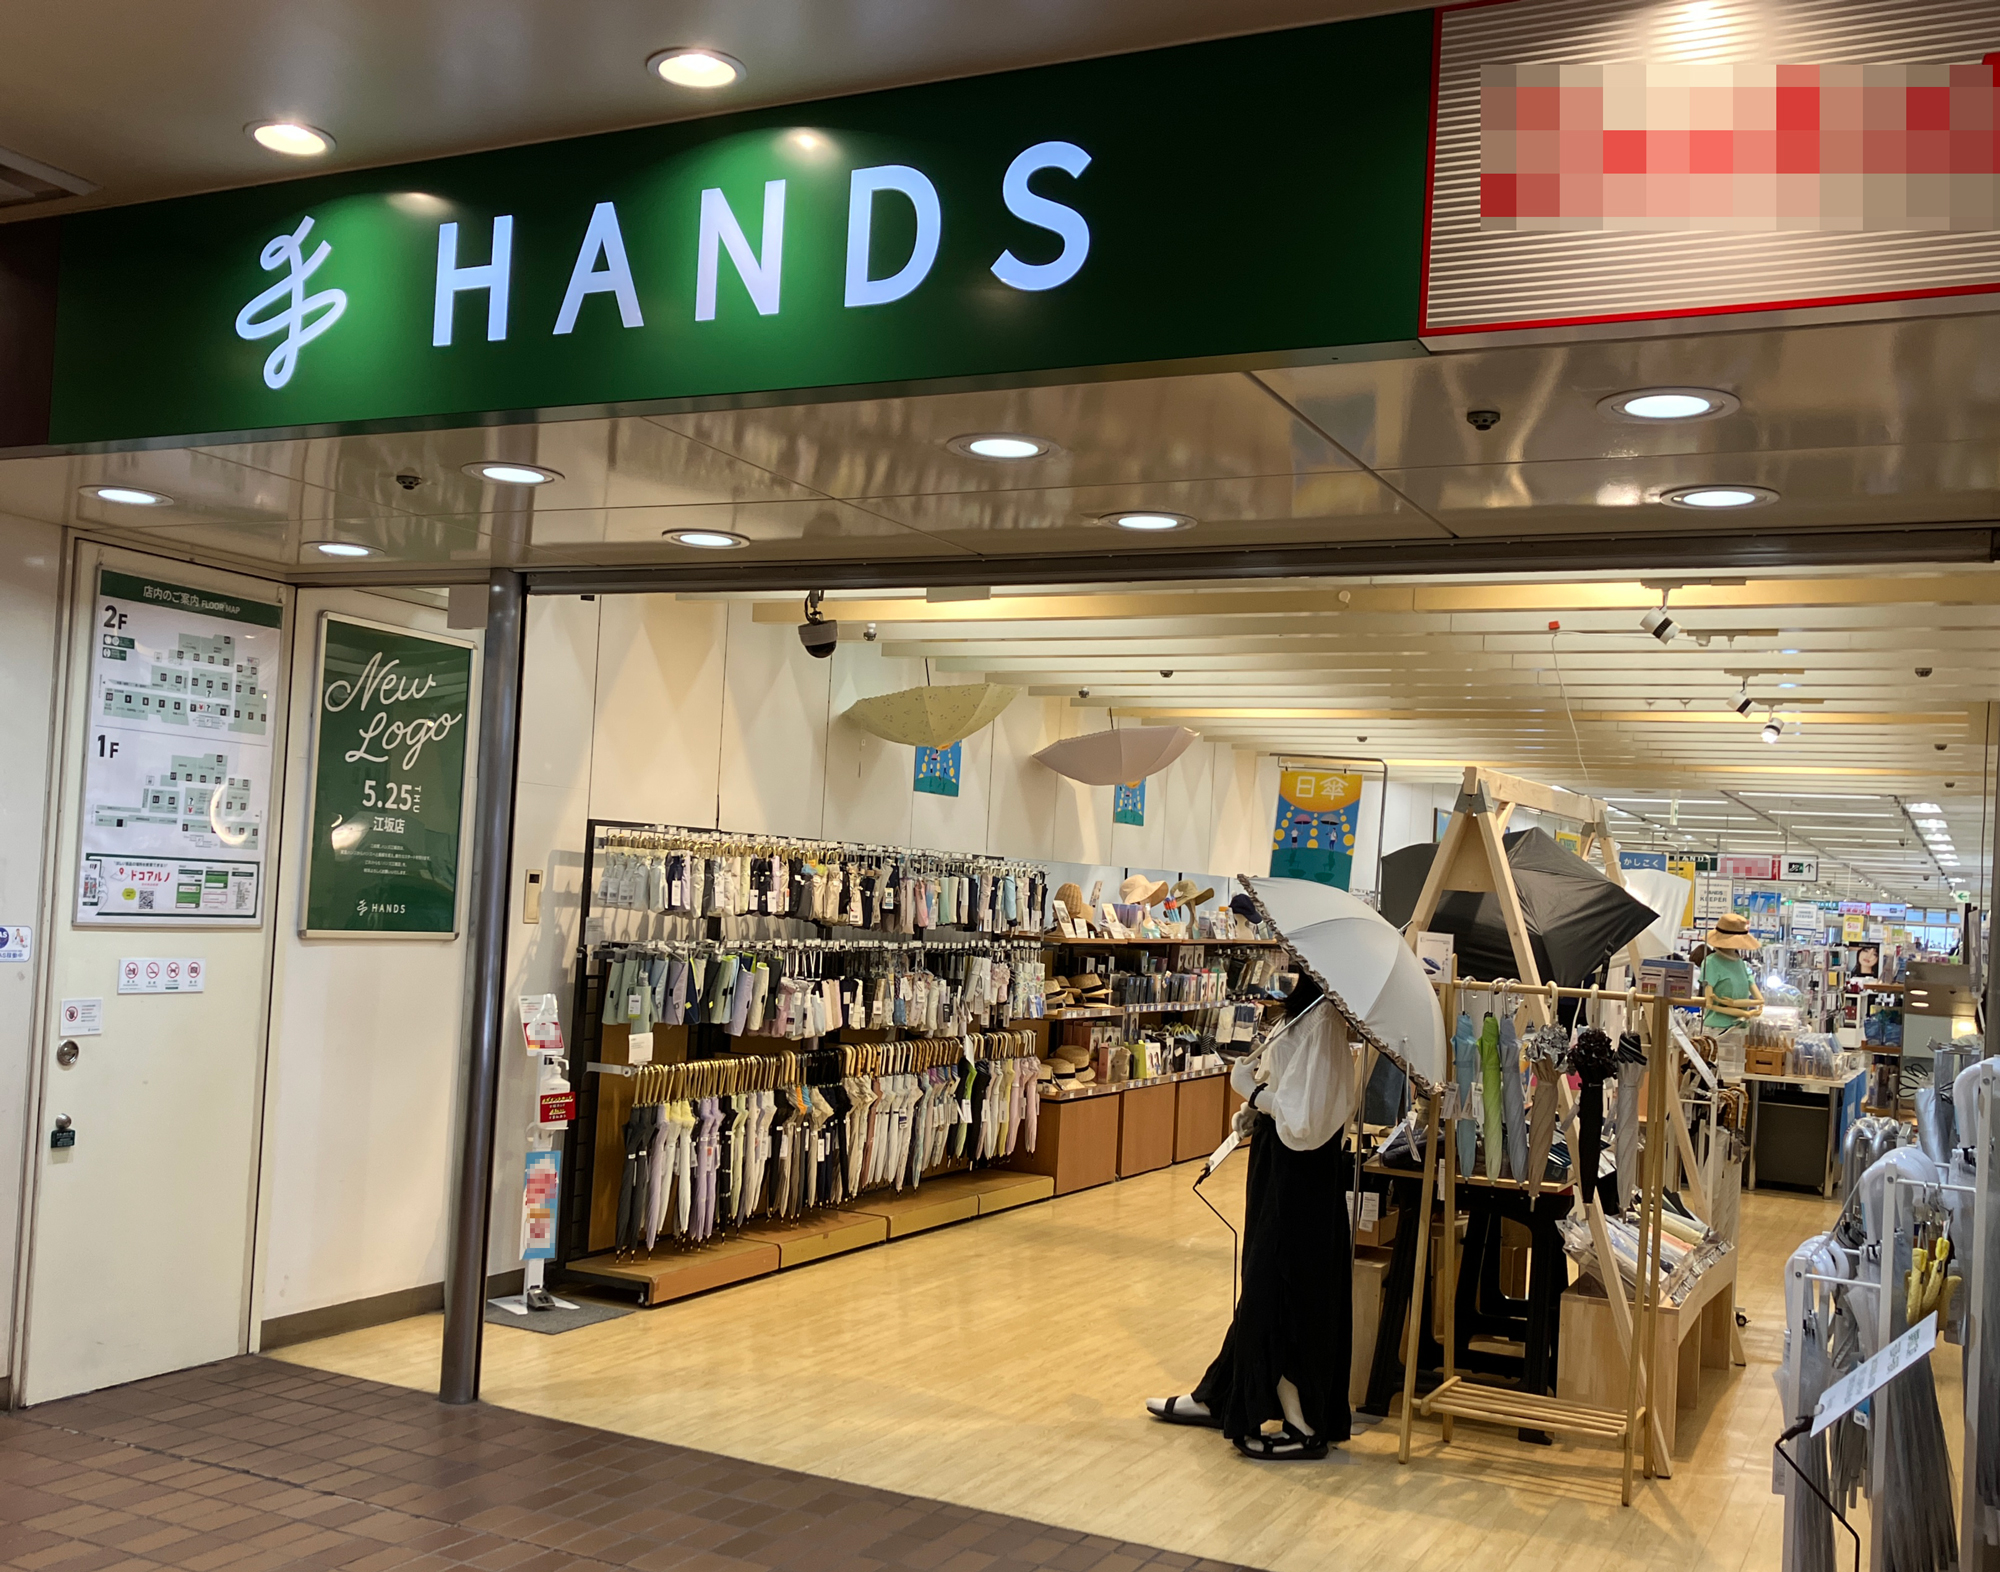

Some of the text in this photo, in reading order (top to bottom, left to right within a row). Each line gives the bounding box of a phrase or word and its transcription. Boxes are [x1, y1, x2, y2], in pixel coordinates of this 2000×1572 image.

[432, 140, 1093, 347] HANDS
[143, 585, 241, 614] 店内のご案内 FLOOR MAP
[103, 604, 128, 630] 2F
[324, 652, 437, 712] New
[97, 734, 120, 759] 1F
[345, 711, 463, 771] Logo
[362, 780, 422, 813] 5.25 THU
[1296, 776, 1349, 801] 日傘
[372, 816, 405, 834] 江坂店
[1623, 858, 1659, 867] かしこく
[131, 869, 171, 883] ドコアルノ
[371, 903, 406, 914] HANDS
